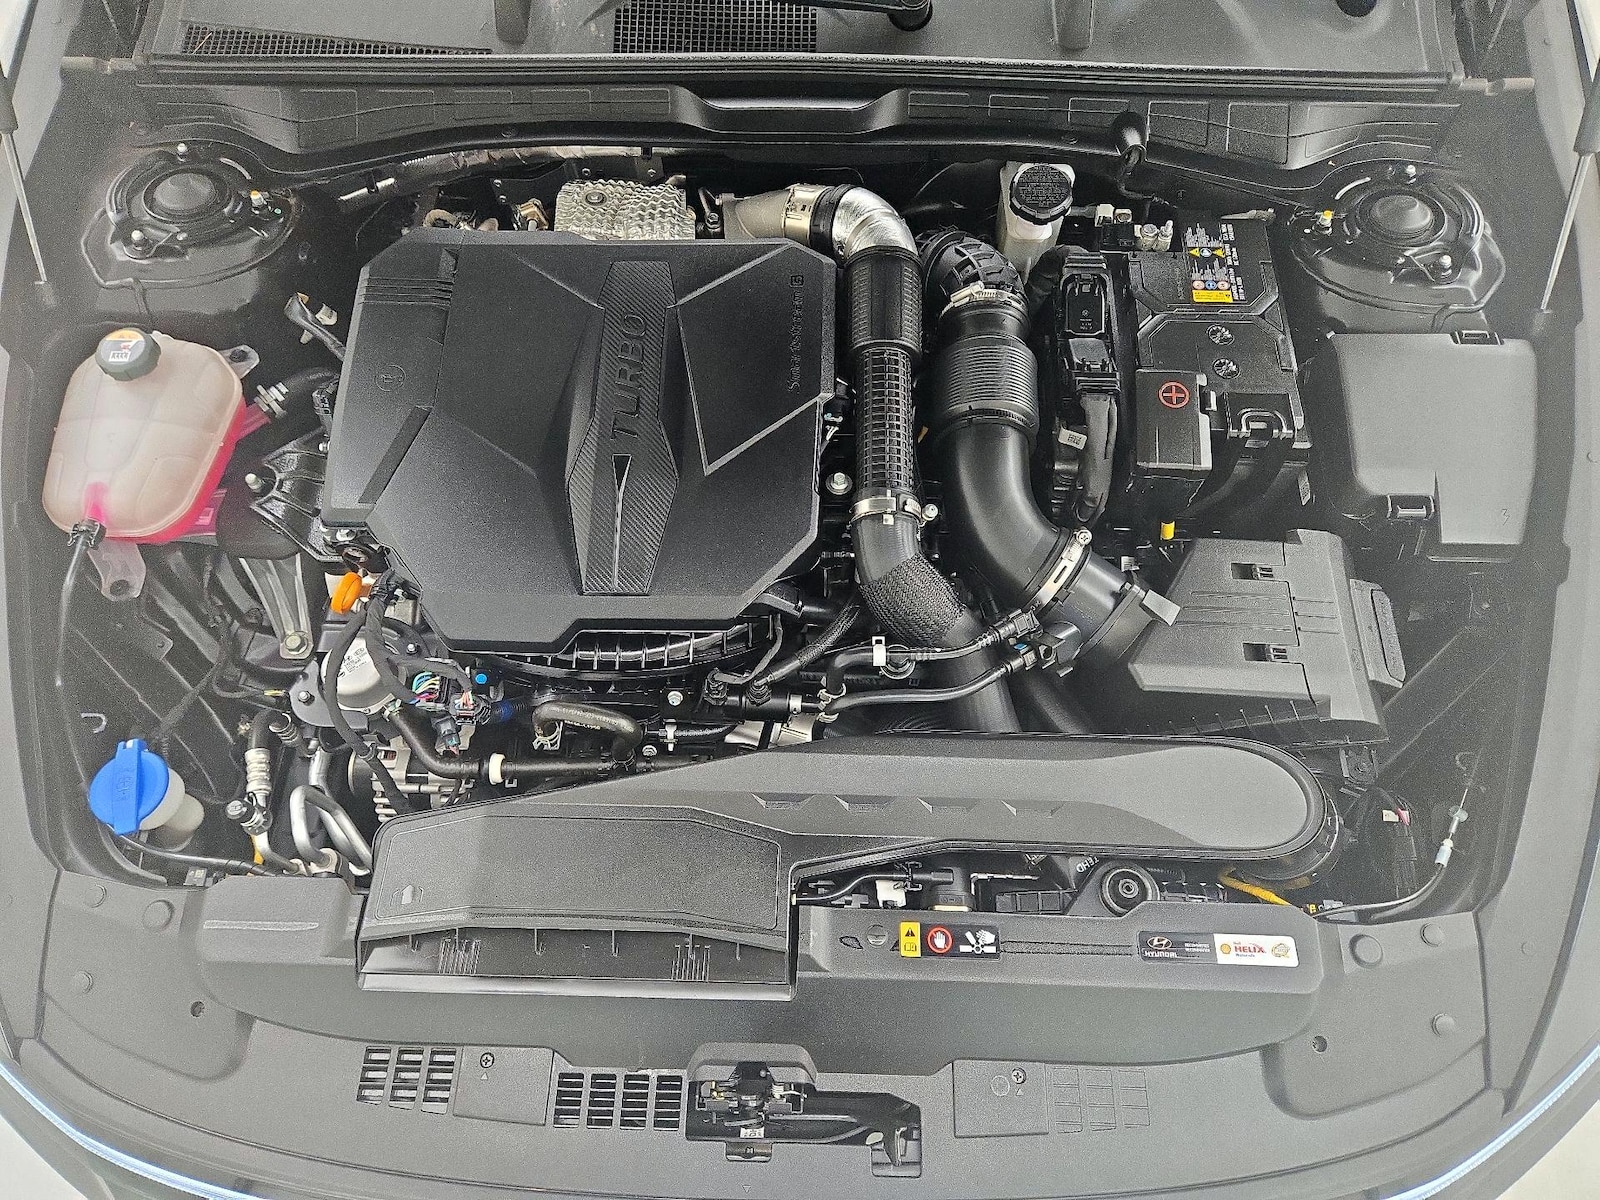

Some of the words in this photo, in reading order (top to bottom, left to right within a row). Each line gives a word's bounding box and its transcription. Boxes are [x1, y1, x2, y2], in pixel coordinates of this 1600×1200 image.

[610, 315, 645, 440] TURBO
[1143, 950, 1178, 958] HYUNDAI
[1234, 945, 1265, 954] HELIX
